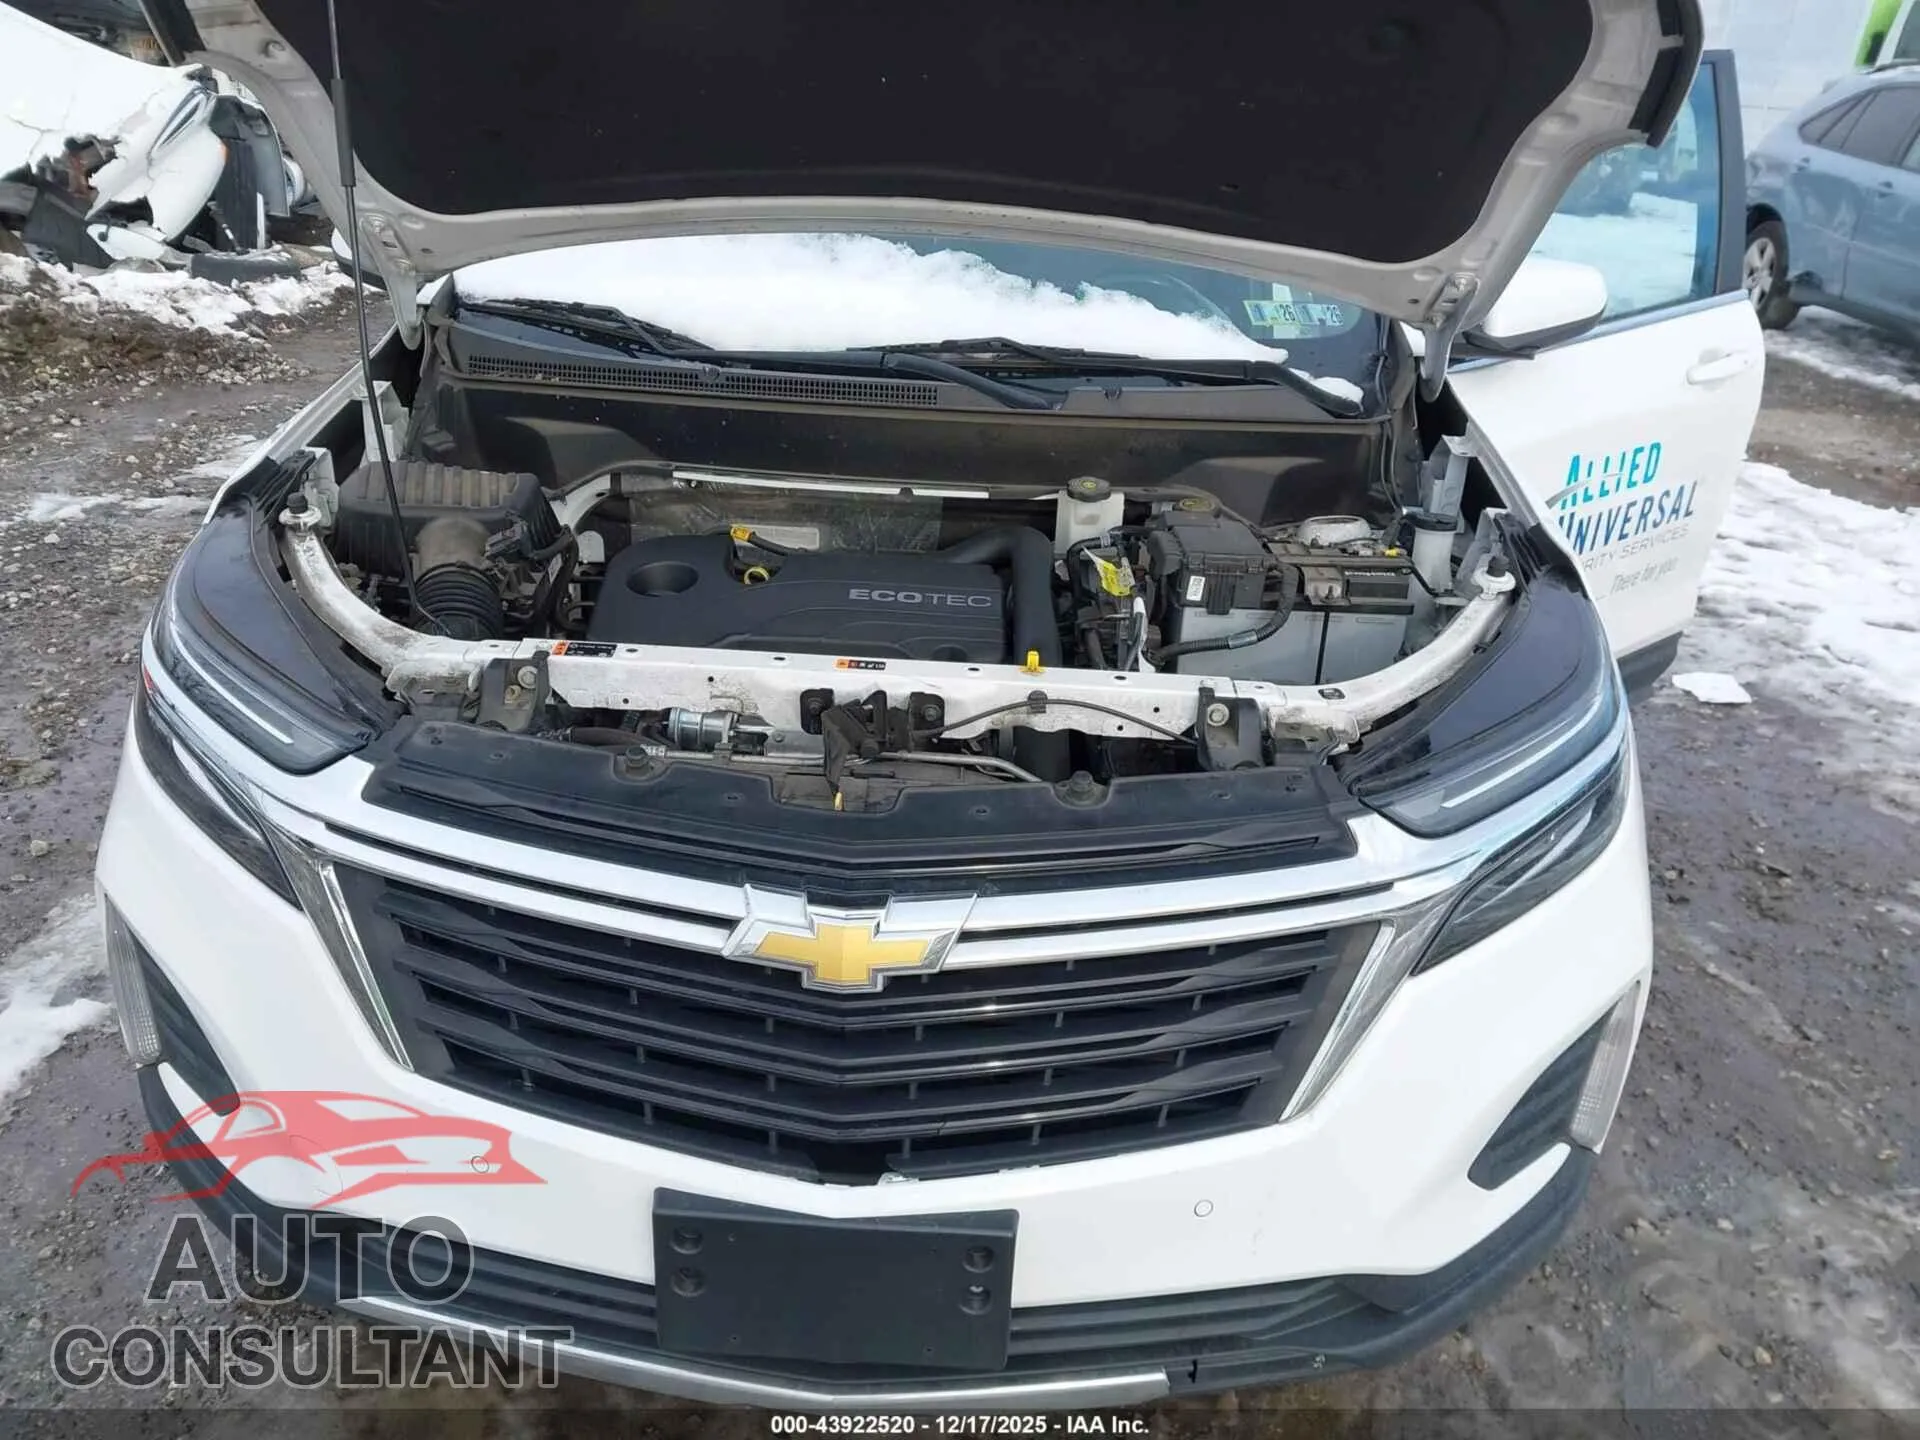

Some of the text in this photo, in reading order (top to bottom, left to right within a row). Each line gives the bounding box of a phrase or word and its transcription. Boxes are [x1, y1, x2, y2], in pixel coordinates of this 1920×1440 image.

[1560, 441, 1662, 510] ALLIED
[1582, 551, 1616, 572] RITY
[849, 588, 992, 608] ECOTEC
